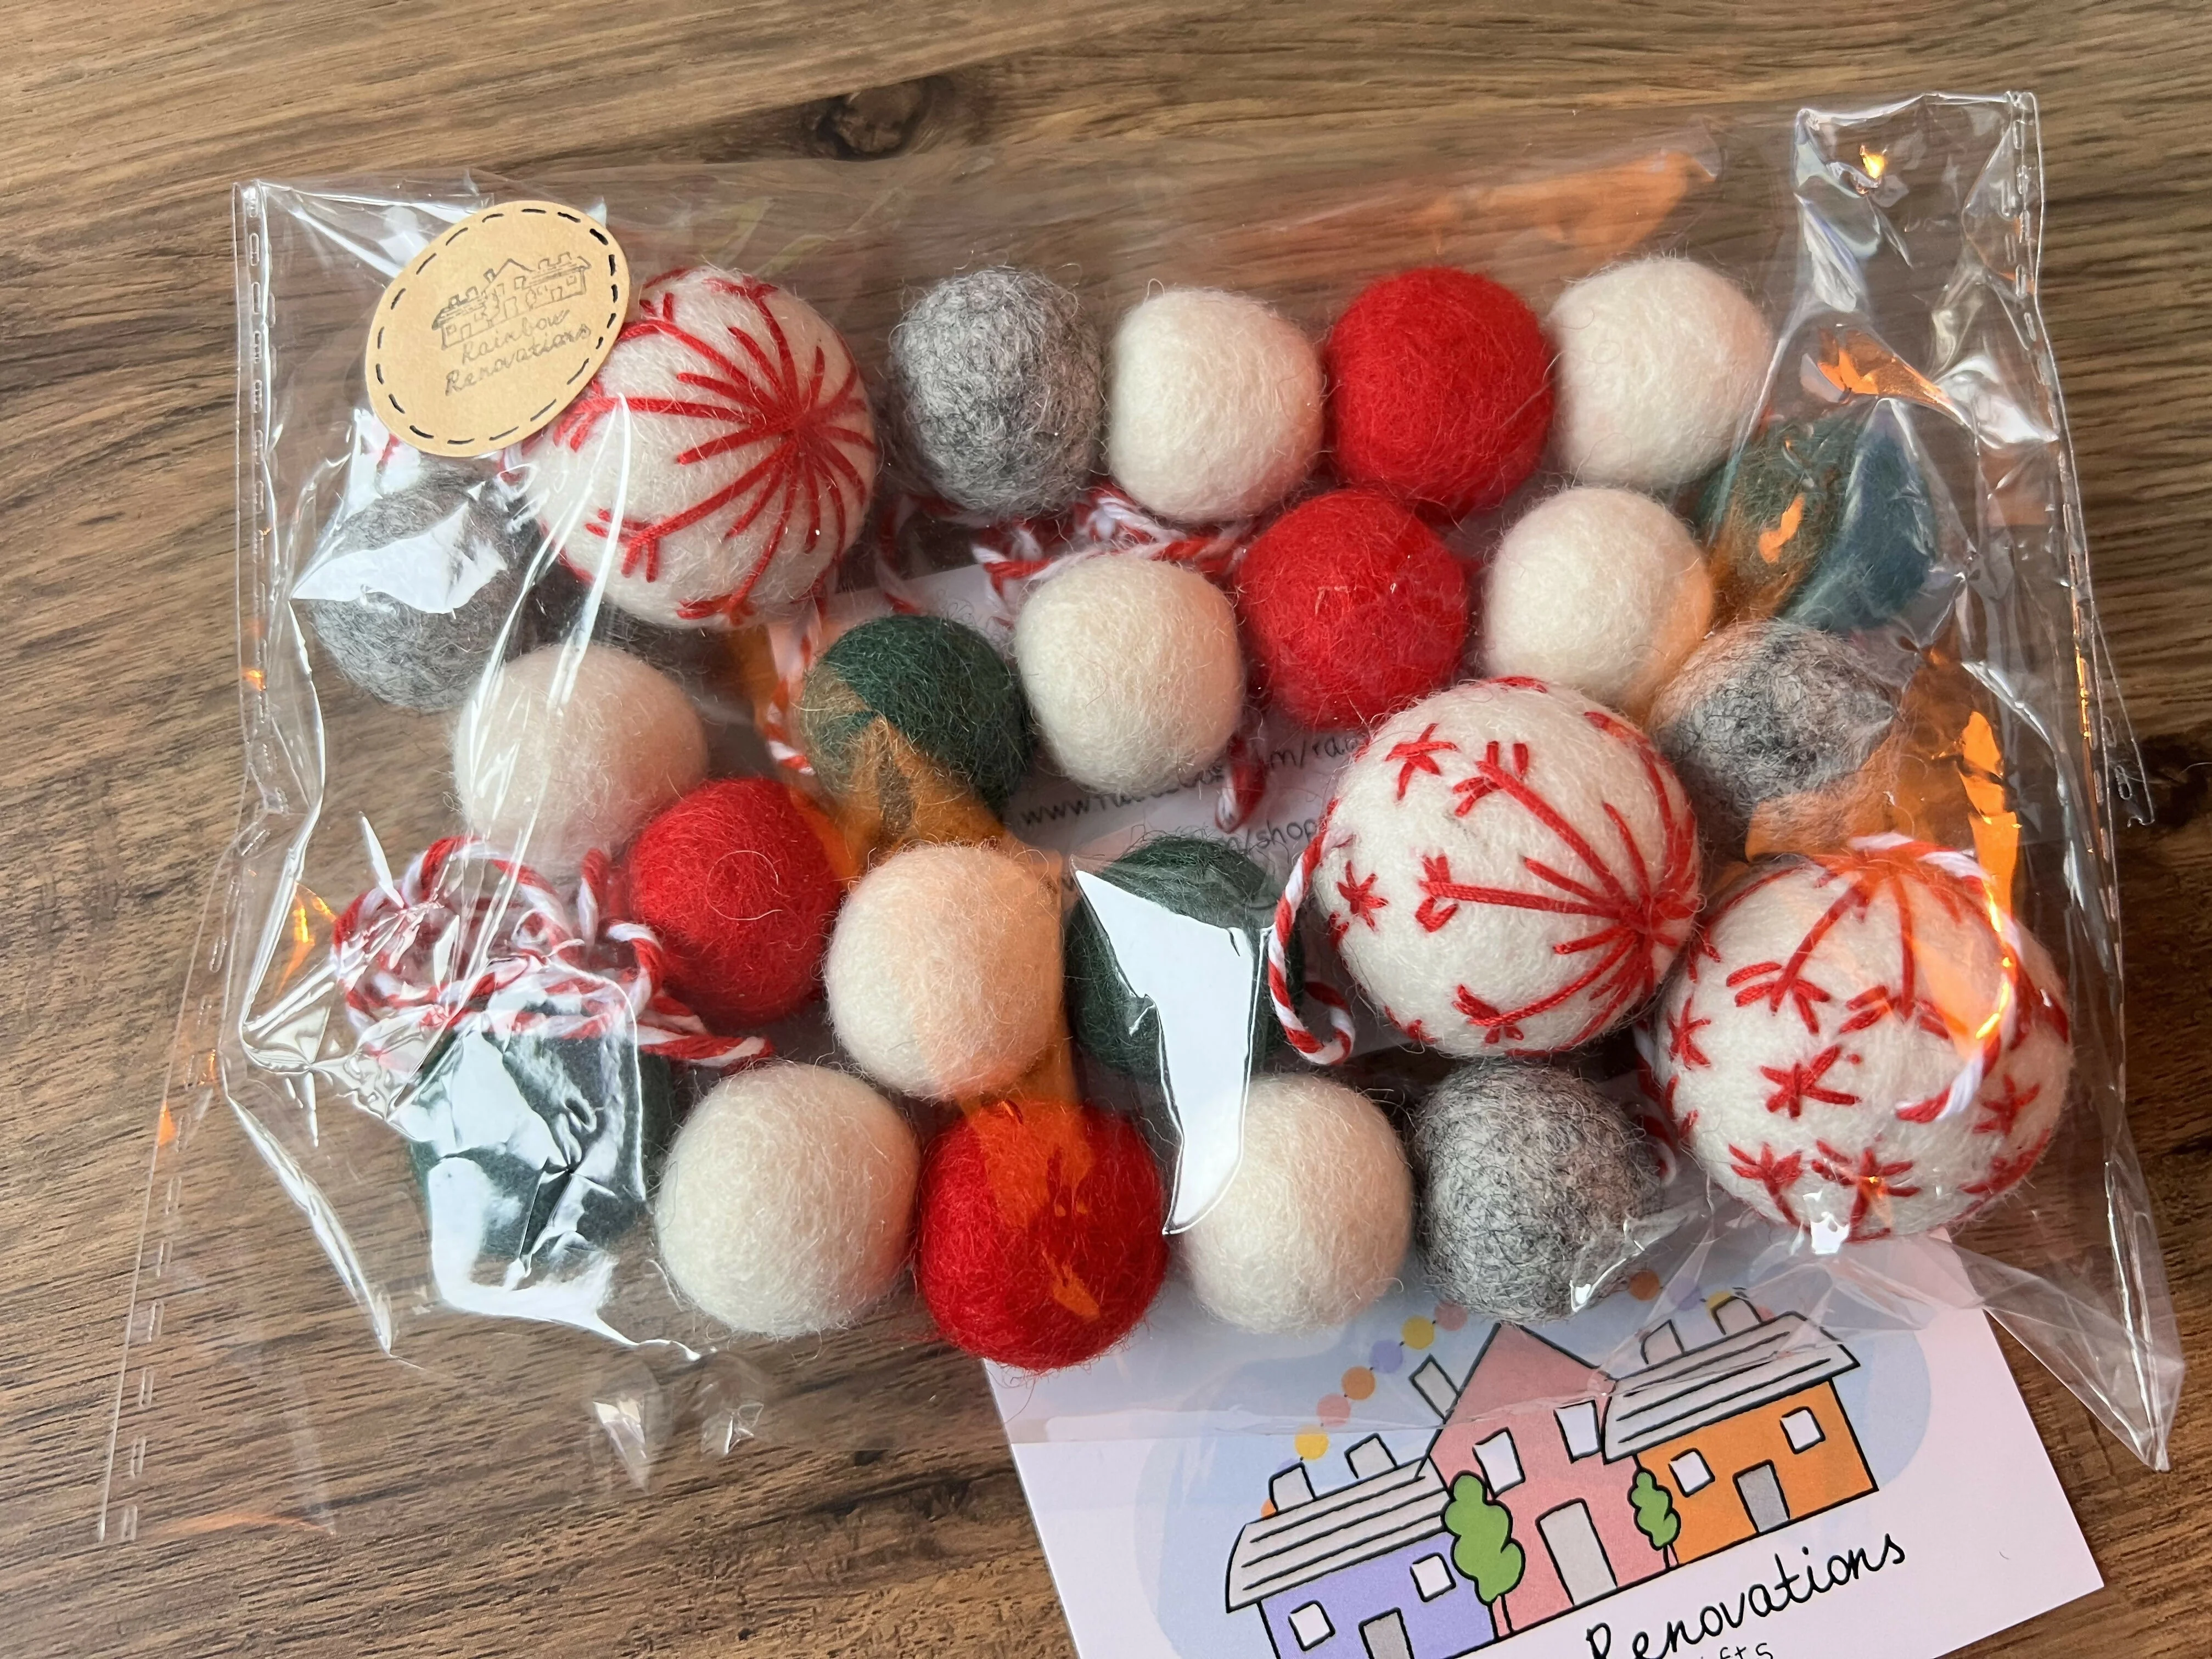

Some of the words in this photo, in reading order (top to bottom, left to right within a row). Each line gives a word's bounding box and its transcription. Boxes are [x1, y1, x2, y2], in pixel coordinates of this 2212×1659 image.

[445, 323, 592, 397] Renovations
[462, 309, 570, 365] Rainbow
[1585, 1533, 1906, 1659] Renovations
